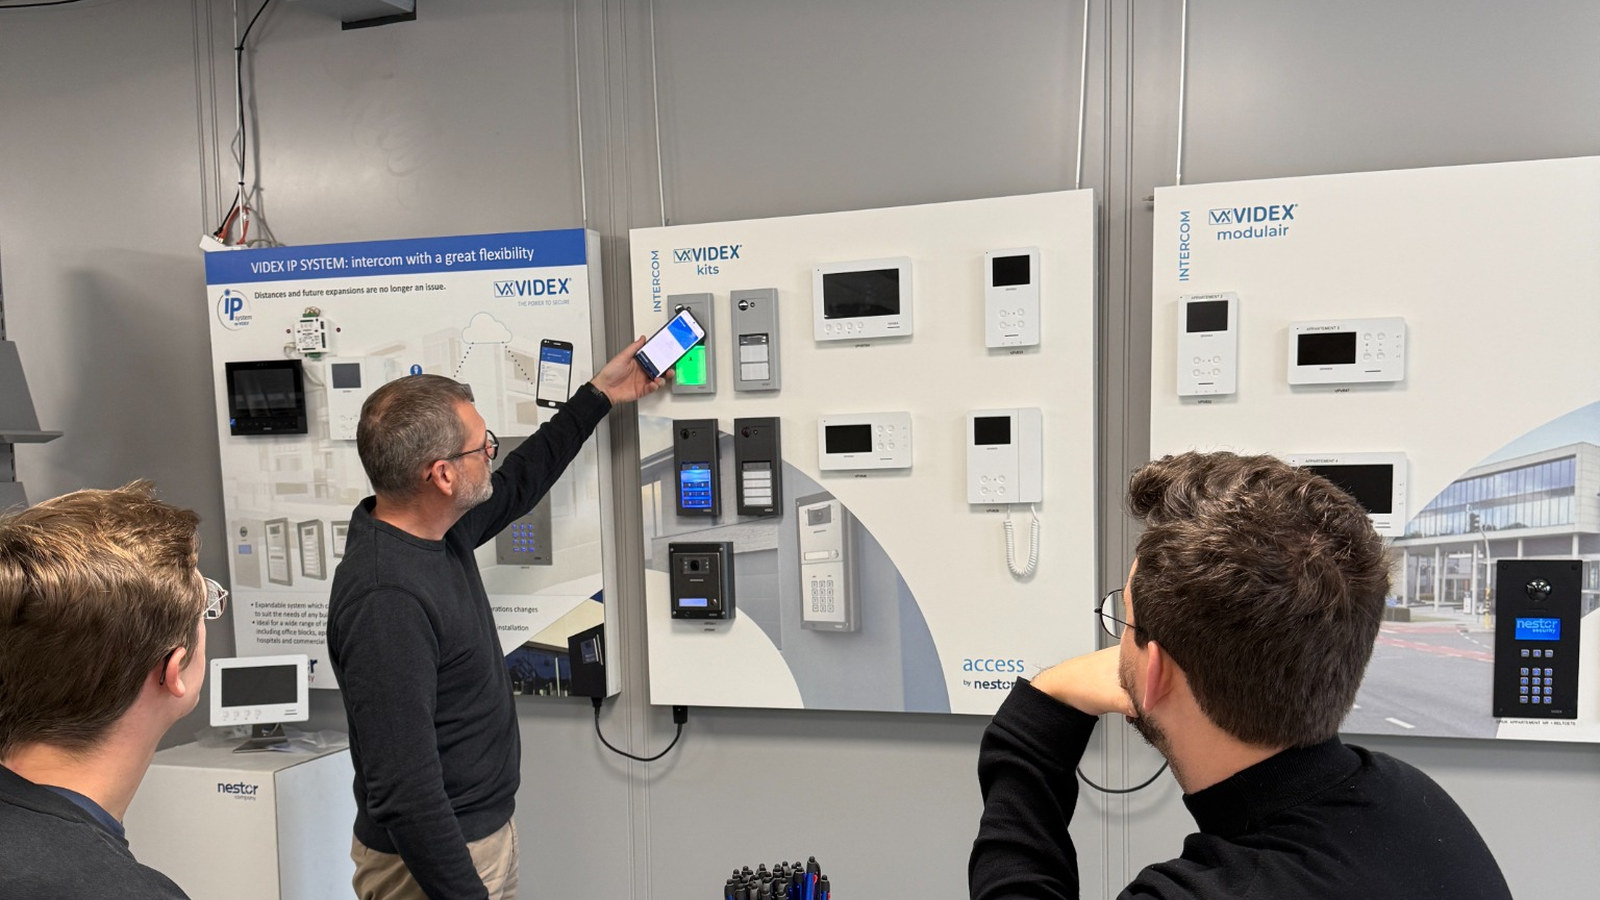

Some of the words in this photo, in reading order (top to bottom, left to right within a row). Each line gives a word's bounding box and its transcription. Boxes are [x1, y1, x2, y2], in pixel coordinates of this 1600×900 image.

[1234, 204, 1294, 223] VIDEX
[1217, 224, 1289, 240] modulair
[693, 245, 740, 261] VIDEX
[1179, 211, 1190, 281] INTERCOM
[251, 260, 284, 274] VIDEX
[287, 260, 298, 272] IP
[300, 257, 348, 271] SYSTEM:
[352, 254, 402, 268] intercom
[406, 252, 432, 265] with
[435, 254, 442, 264] a
[445, 250, 476, 266] great
[479, 246, 534, 262] flexibility
[698, 264, 719, 275] kits
[516, 278, 569, 296] VIDEX
[651, 251, 661, 312] INTERCOM
[254, 291, 286, 299] Distances
[288, 290, 300, 298] and
[326, 287, 364, 297] expansions
[390, 283, 413, 294] longer
[1516, 619, 1558, 628] nestor
[963, 659, 1024, 672] access
[217, 782, 258, 795] nestor
